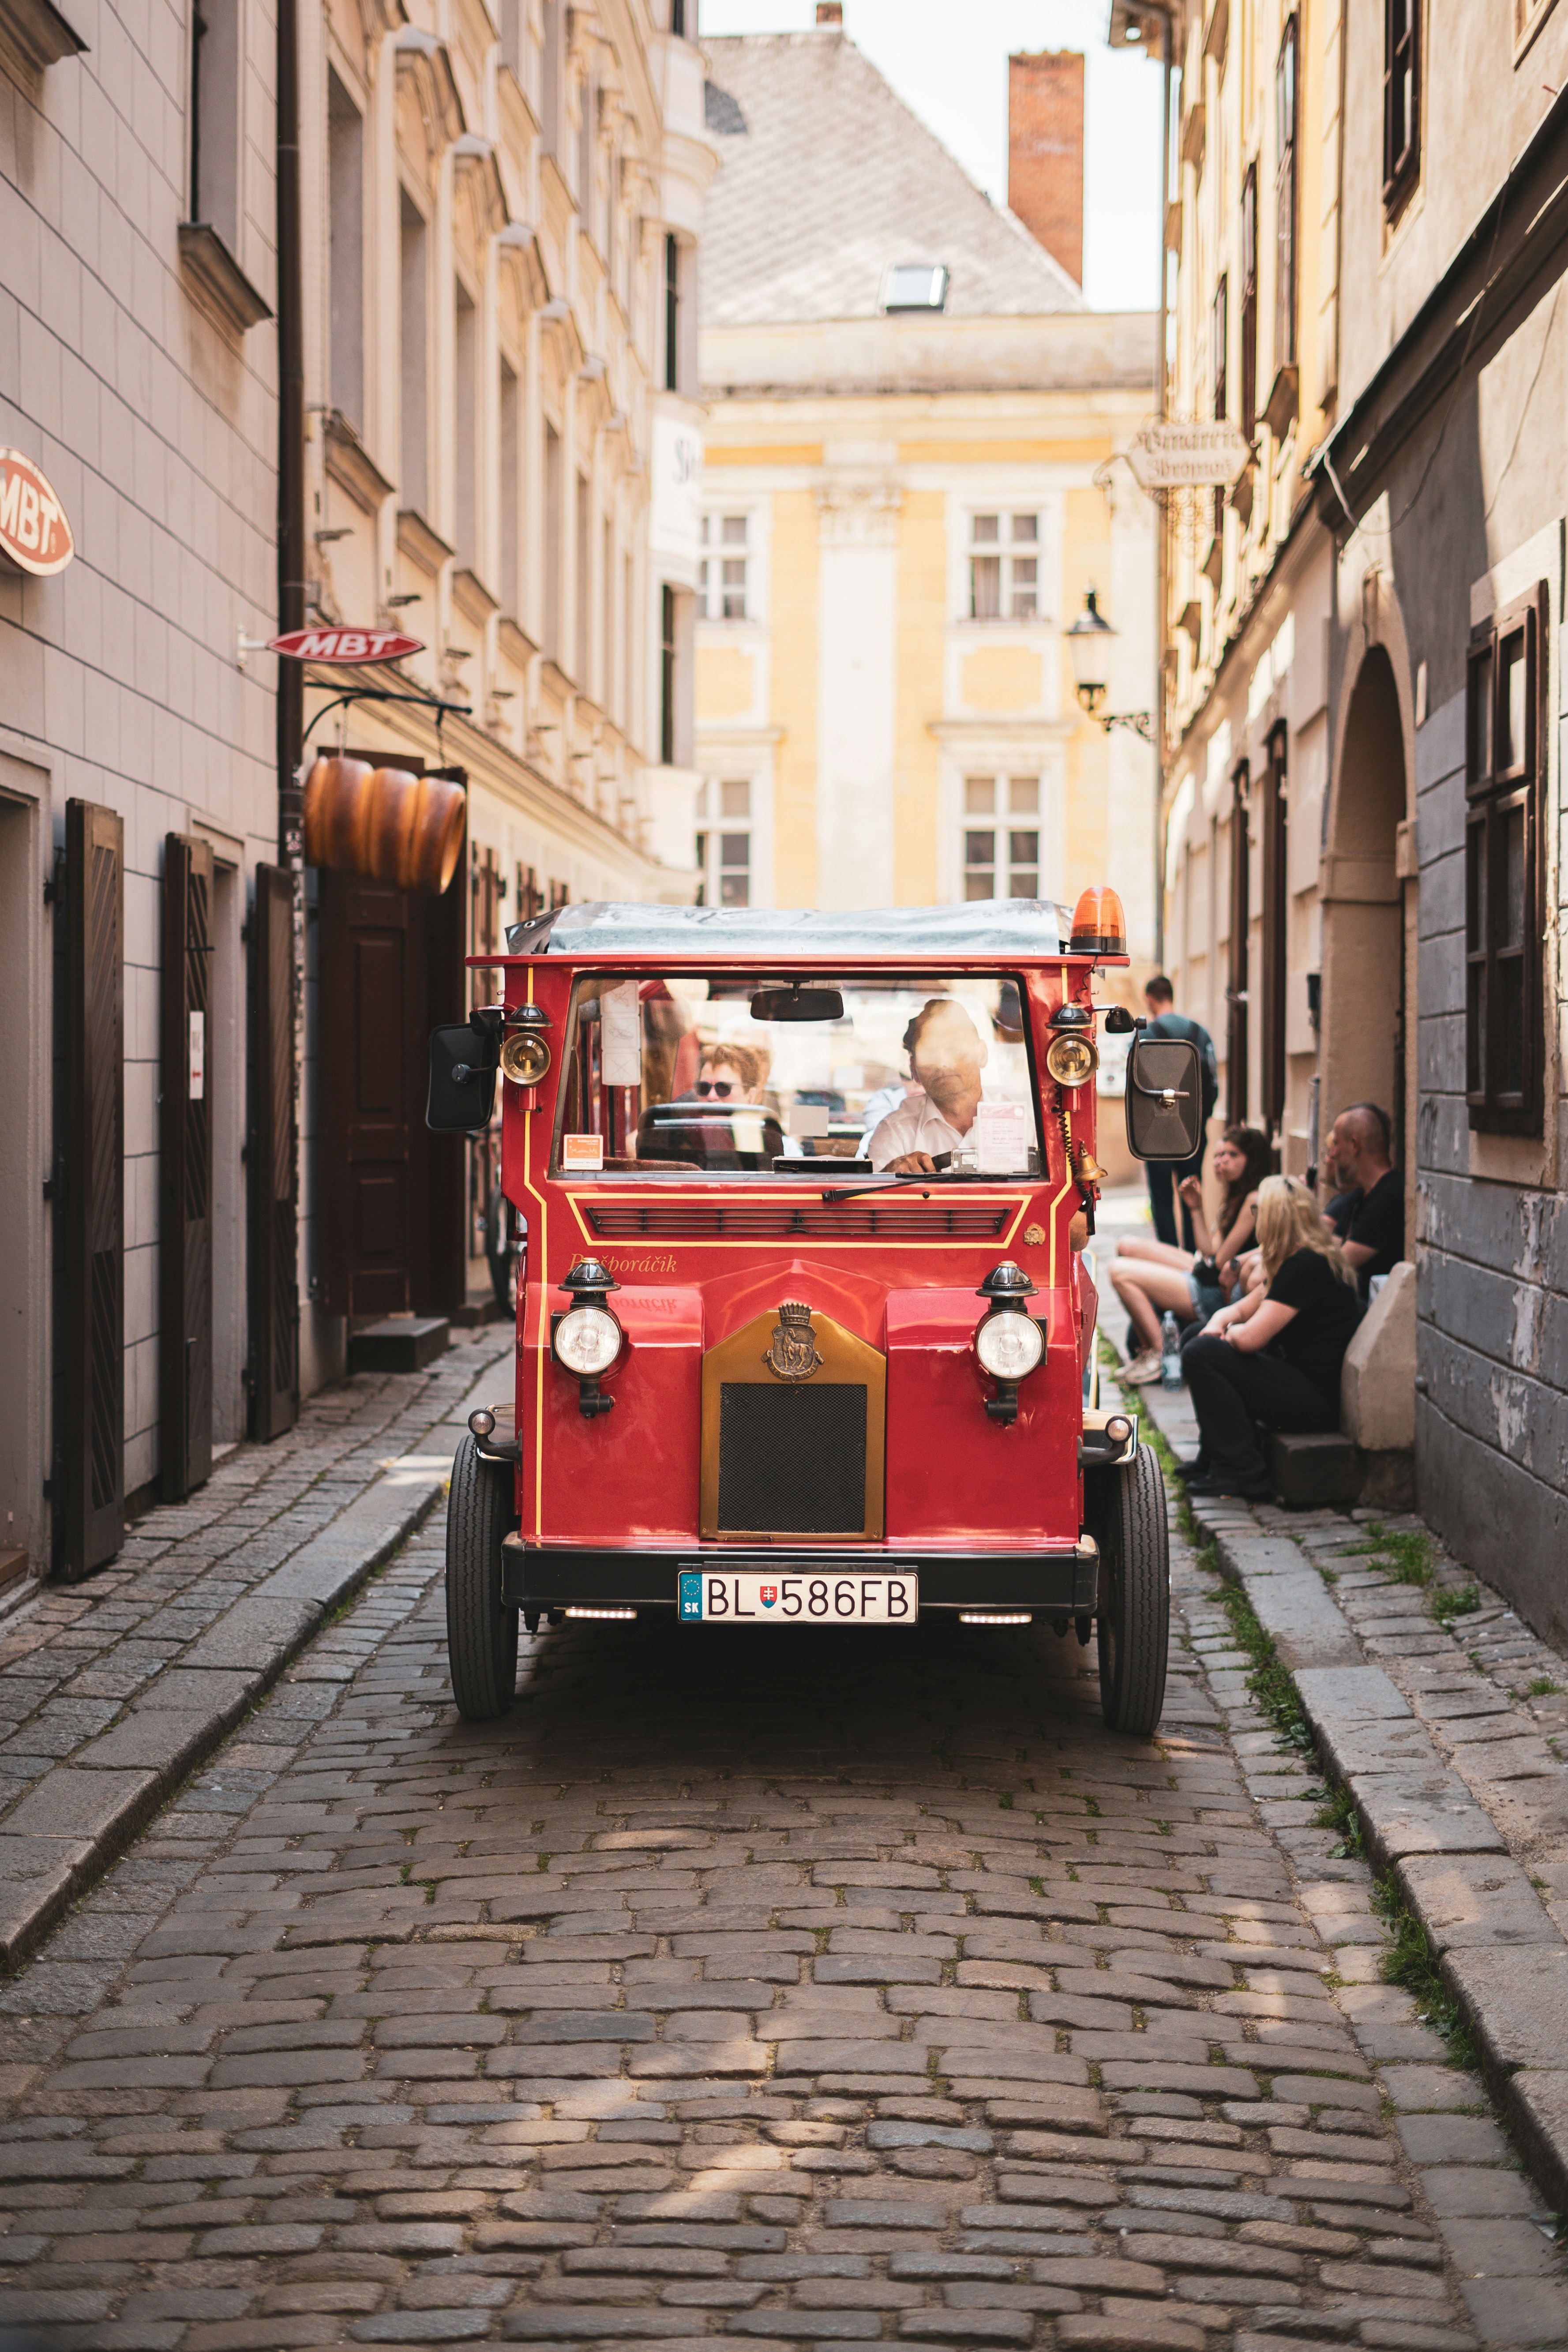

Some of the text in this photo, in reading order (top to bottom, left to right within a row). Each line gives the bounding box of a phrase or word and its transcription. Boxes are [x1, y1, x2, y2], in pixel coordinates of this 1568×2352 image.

[0, 466, 58, 555] MBT
[296, 632, 398, 656] MBT
[567, 1253, 677, 1273] Pšporáčik
[684, 1602, 699, 1613] SK
